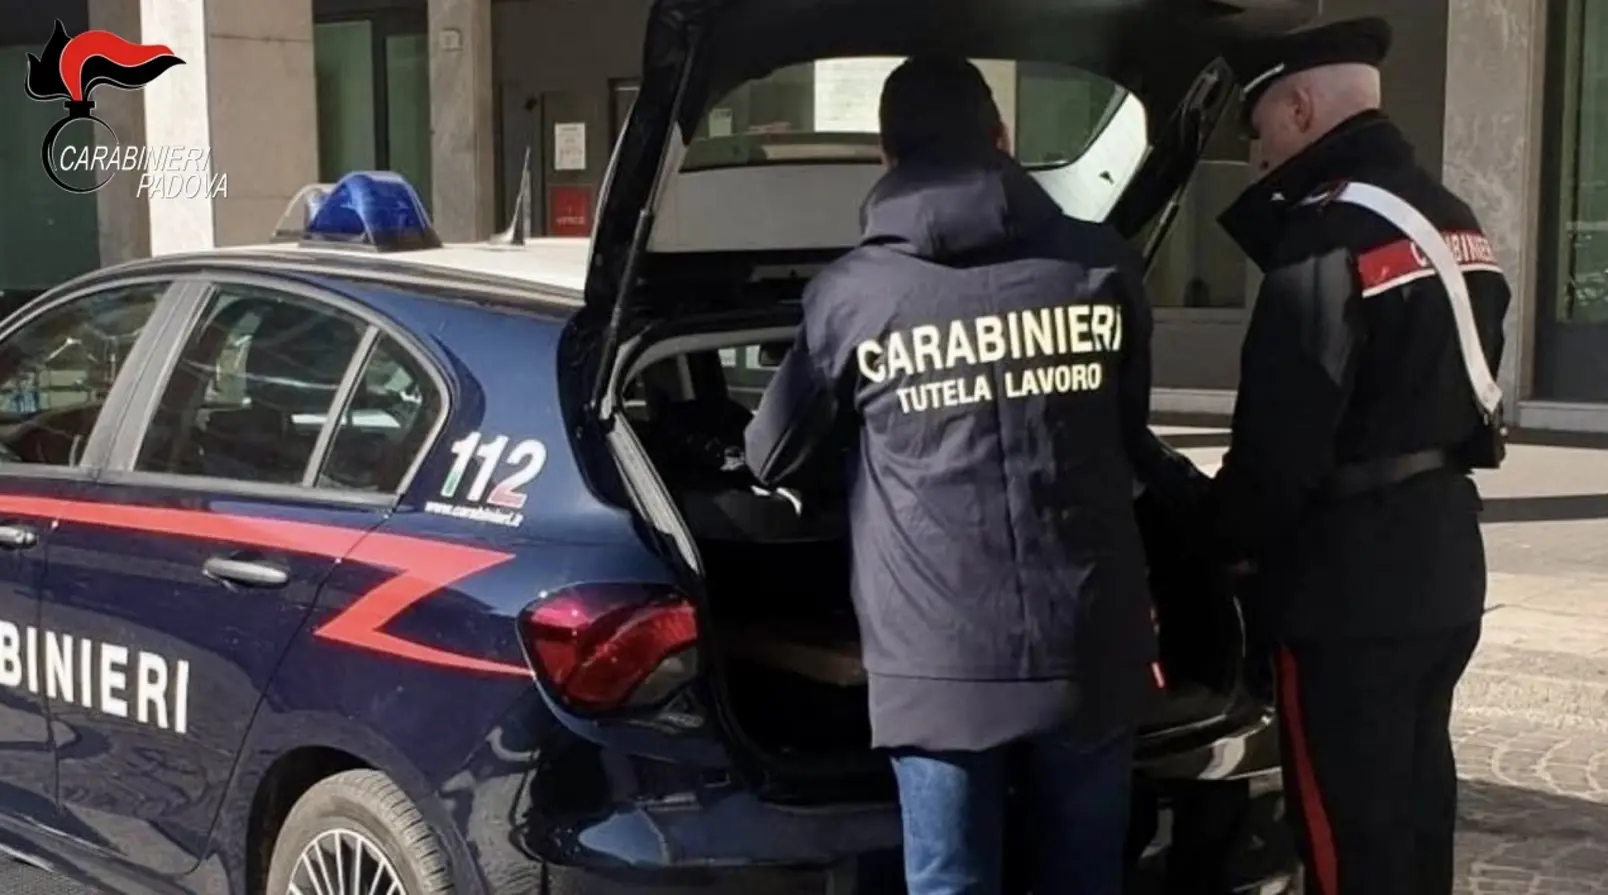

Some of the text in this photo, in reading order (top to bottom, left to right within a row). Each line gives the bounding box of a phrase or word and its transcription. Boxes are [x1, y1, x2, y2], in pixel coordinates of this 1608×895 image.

[896, 363, 1103, 414] TUTELA LAVORO
[441, 431, 547, 509] 112
